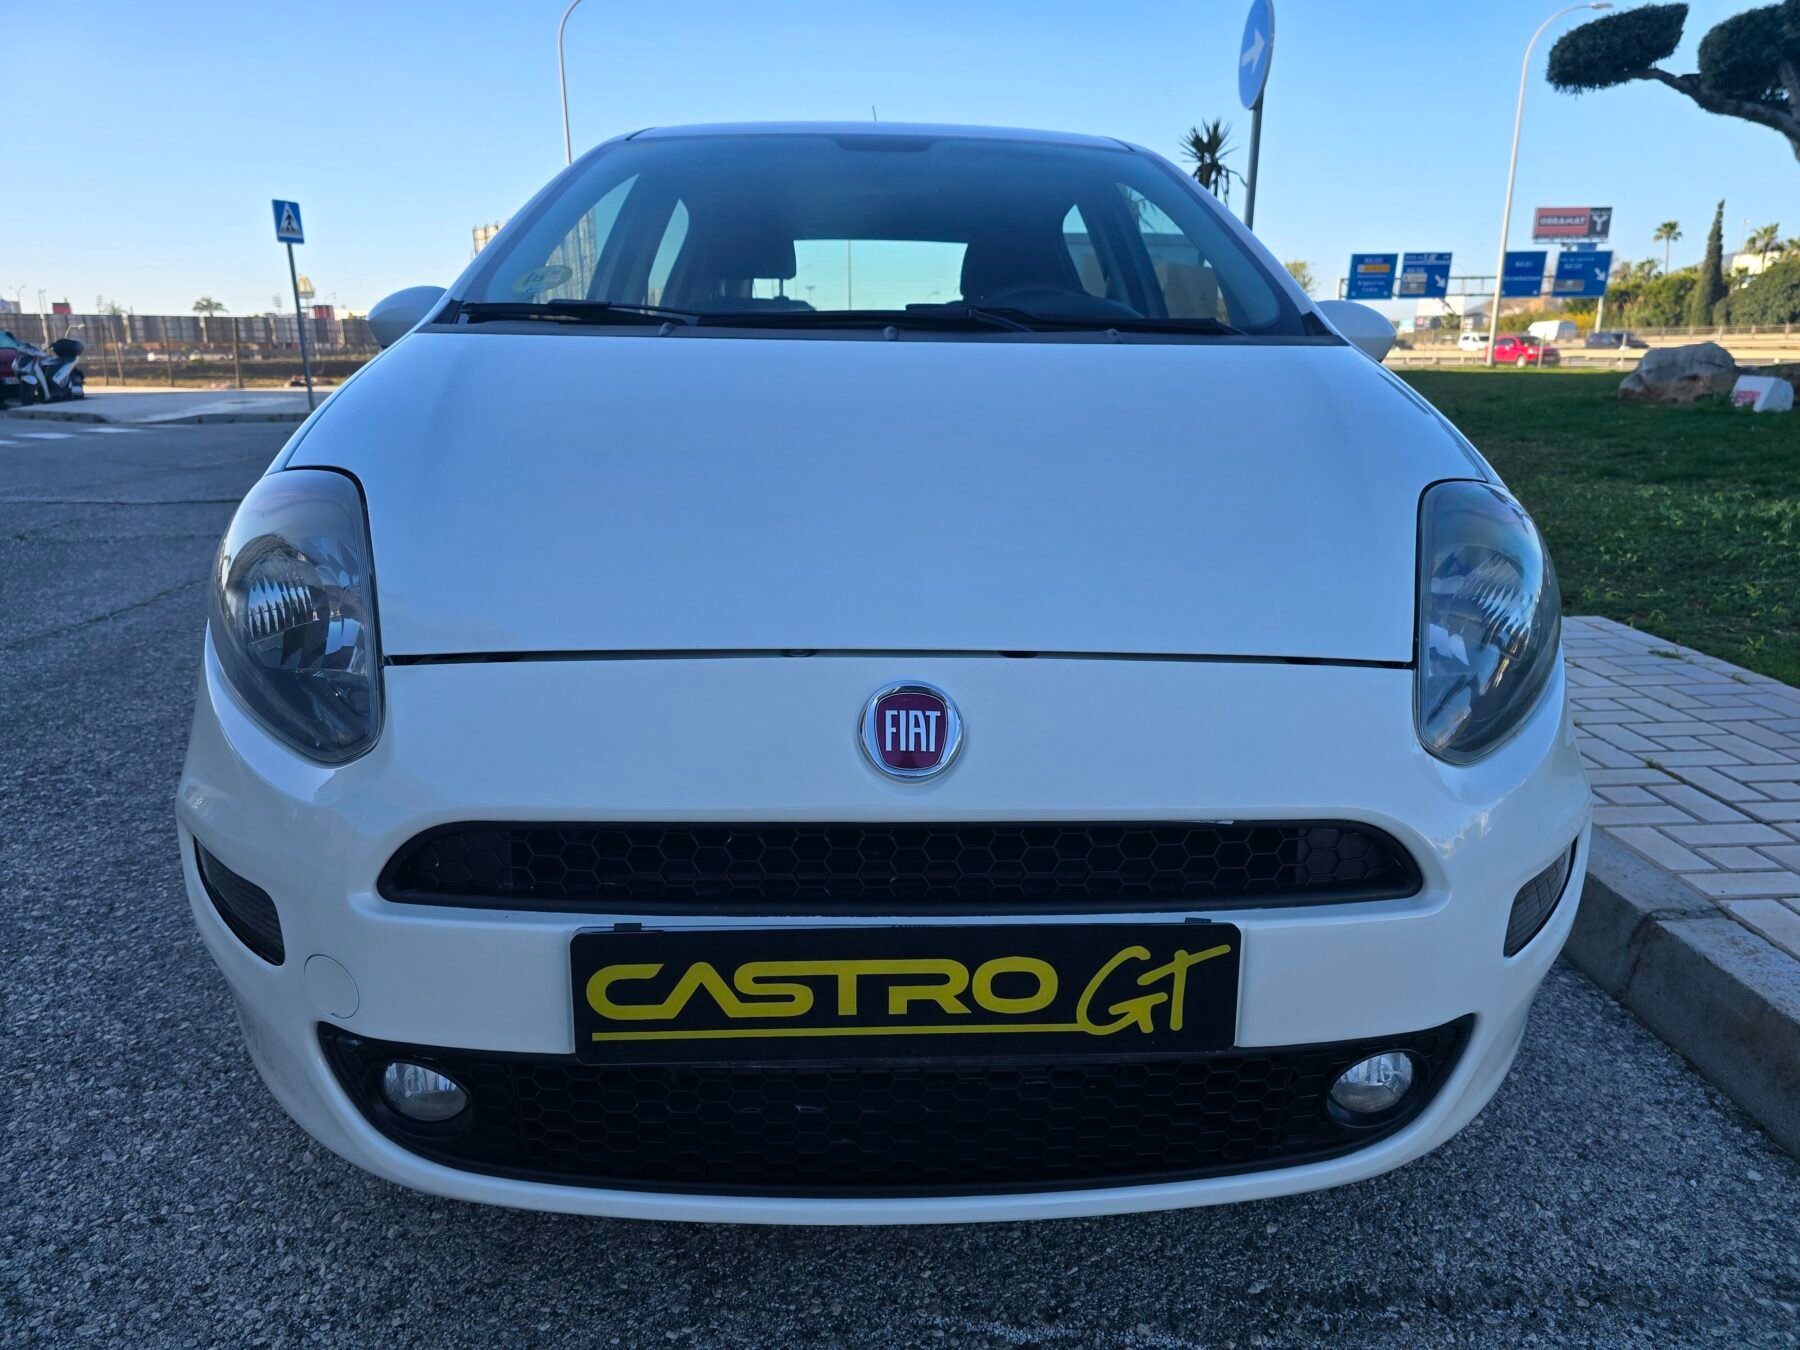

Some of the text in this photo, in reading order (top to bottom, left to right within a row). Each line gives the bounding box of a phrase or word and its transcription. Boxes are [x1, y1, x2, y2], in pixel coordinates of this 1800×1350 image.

[885, 710, 941, 752] FIAT
[586, 944, 1231, 1036] CASTRO GT
